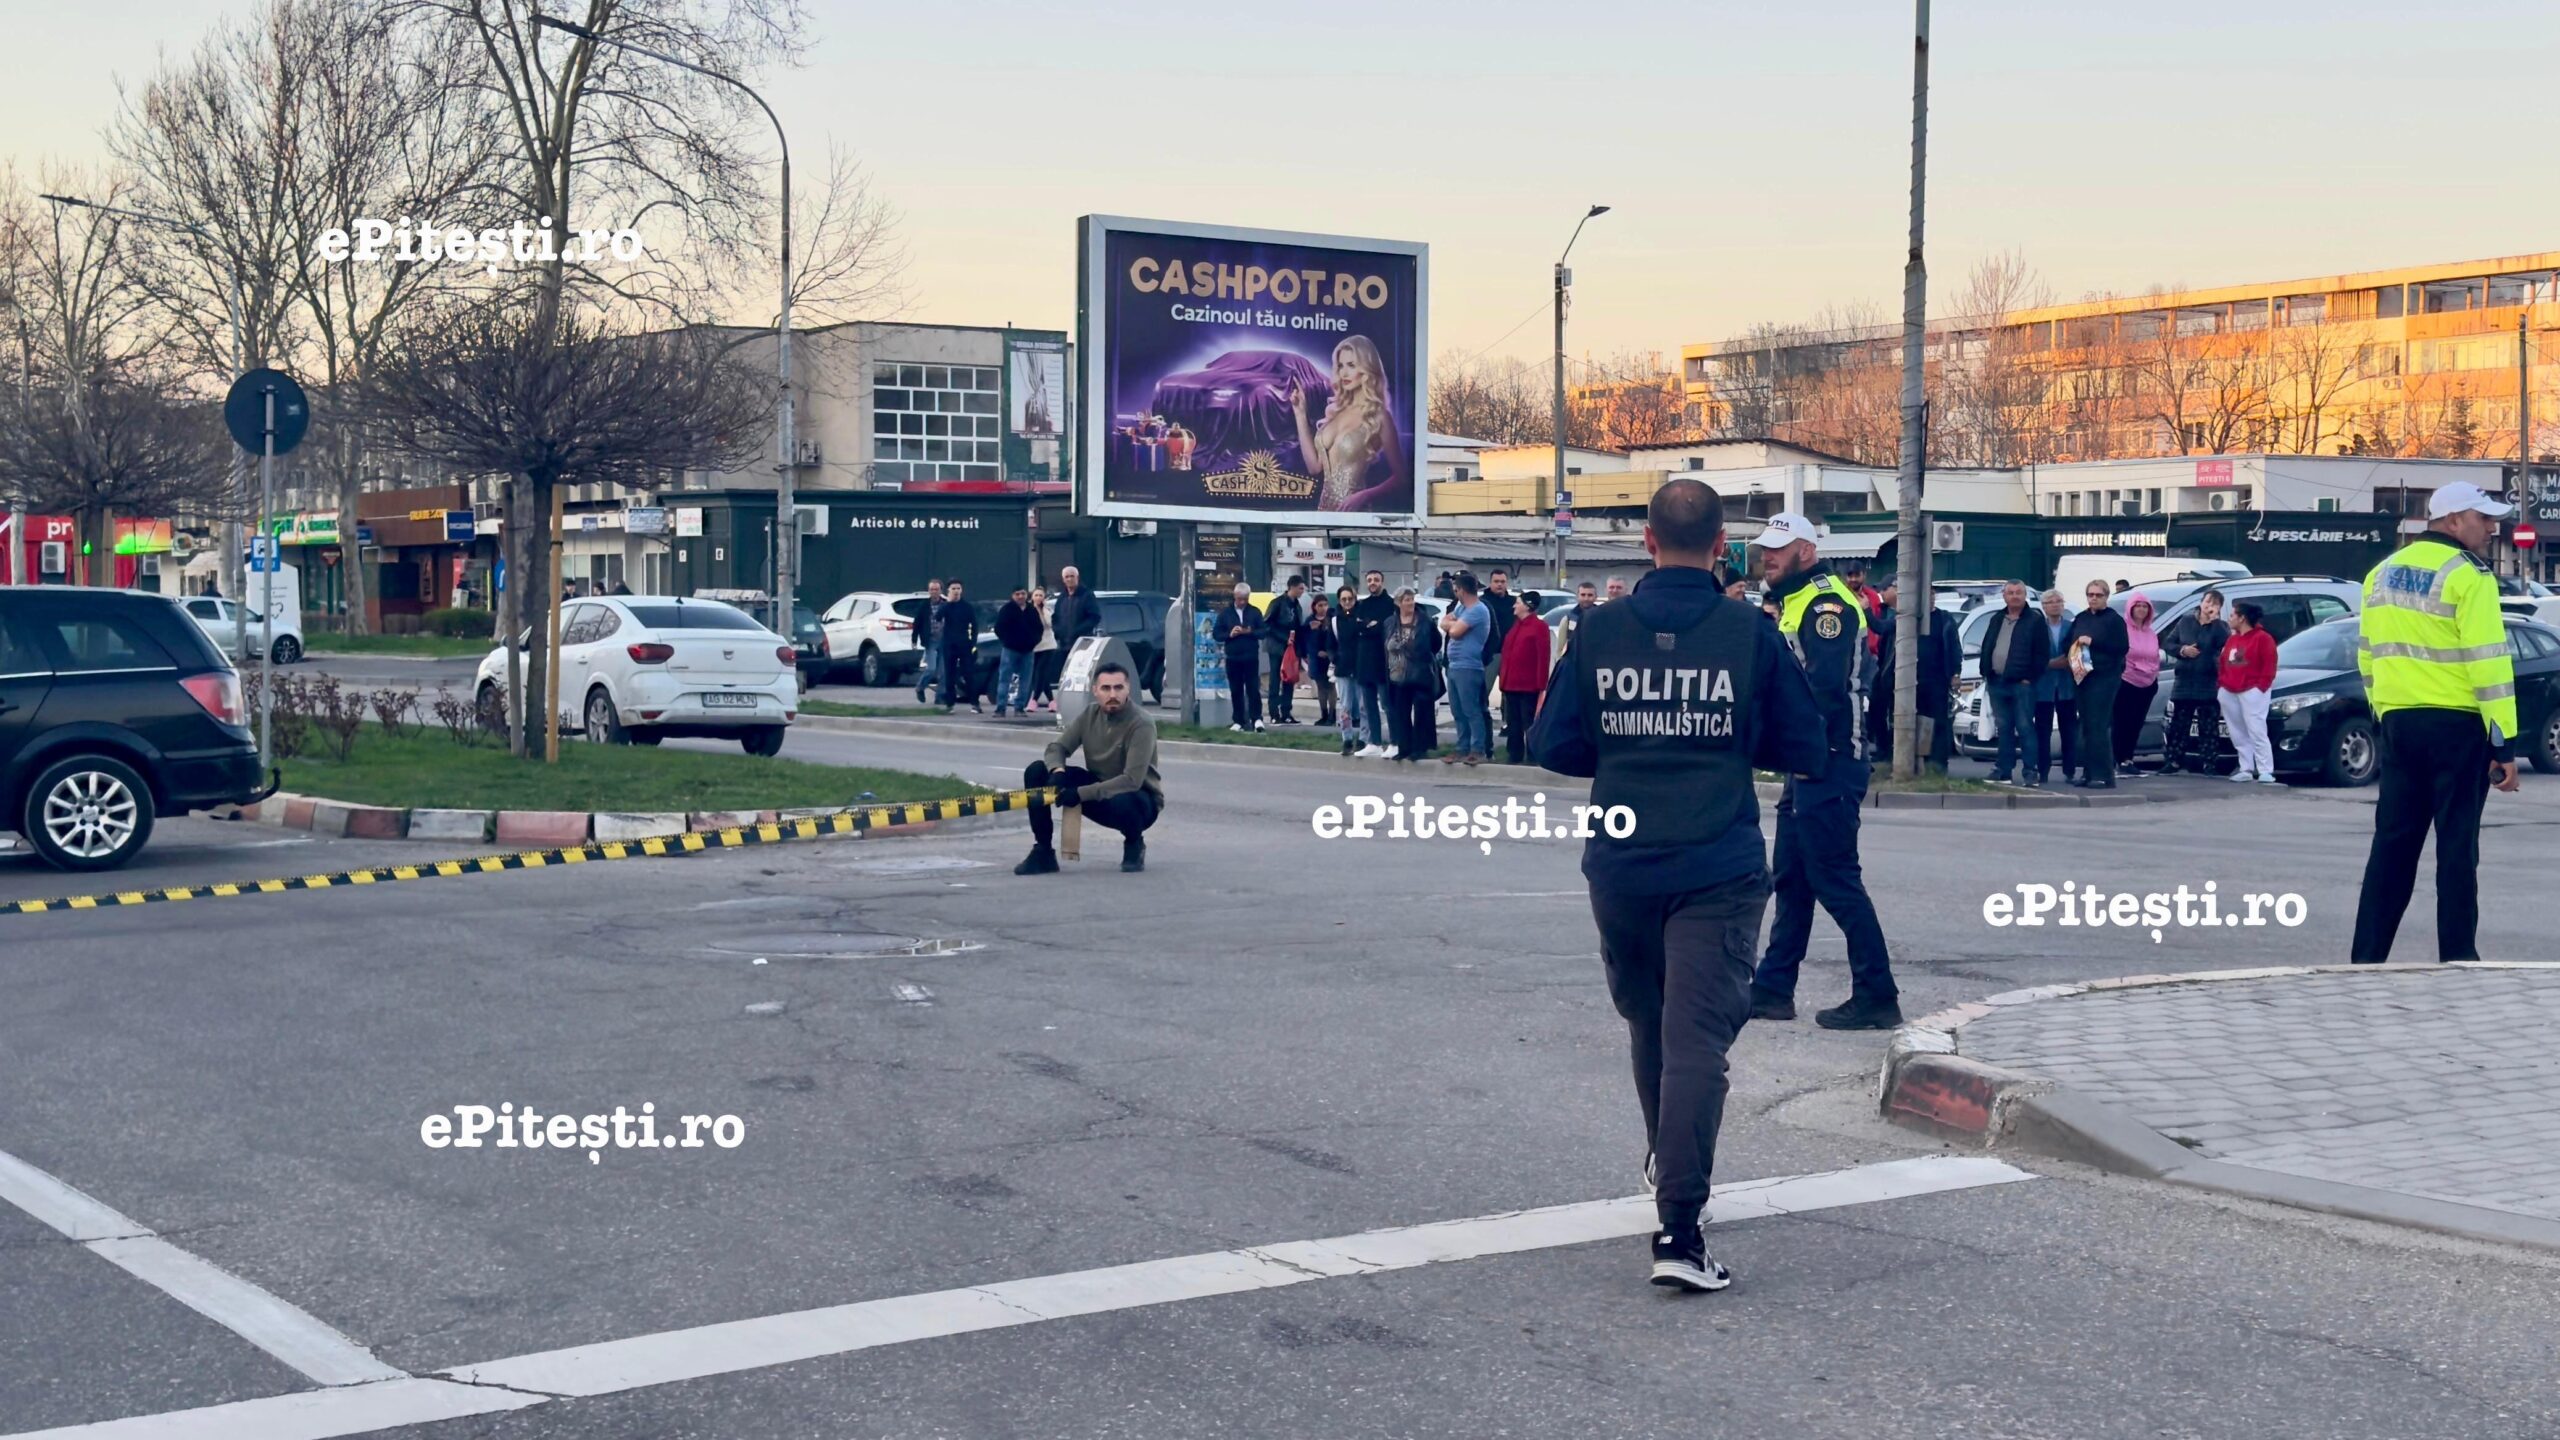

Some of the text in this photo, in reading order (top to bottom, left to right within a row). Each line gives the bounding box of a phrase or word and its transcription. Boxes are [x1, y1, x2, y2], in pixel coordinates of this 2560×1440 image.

[1130, 256, 1388, 309] CASHPOT.RO
[1171, 303, 1348, 332] Cazinoul tău online
[1211, 475, 1307, 492] CASH POT
[1556, 492, 1564, 505] P
[851, 516, 980, 529] Articole de Pescuit
[2268, 528, 2344, 542] PESCĂRIE
[256, 560, 276, 568] TAI
[1596, 667, 1735, 711] POLIȚIA
[1601, 709, 1733, 737] CRIMINALISTICĂ
